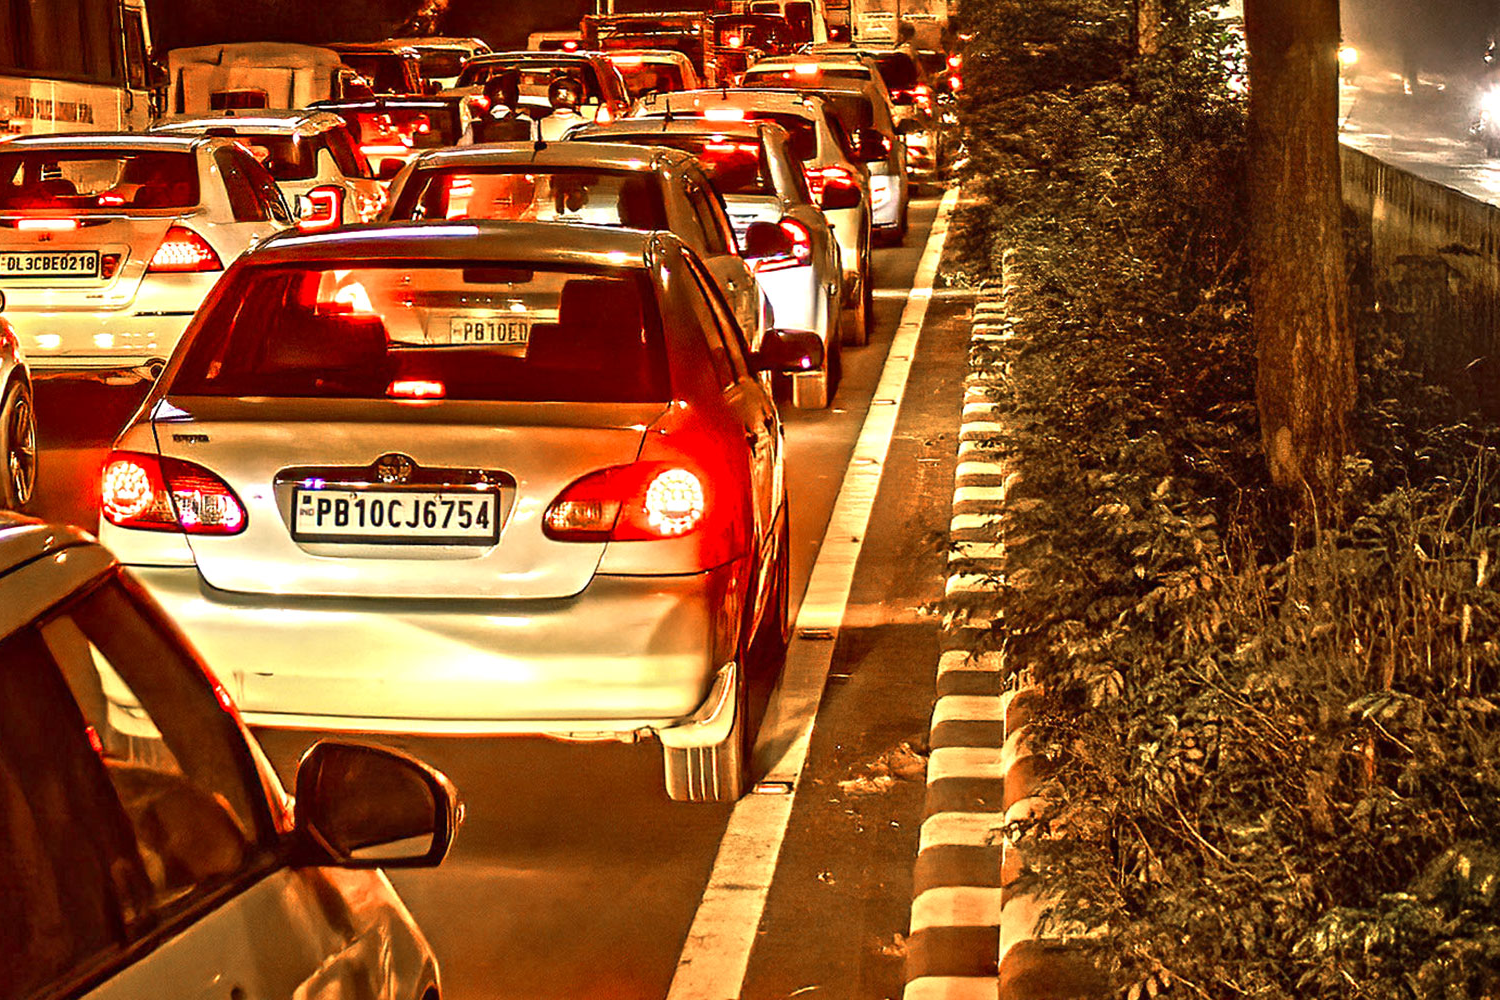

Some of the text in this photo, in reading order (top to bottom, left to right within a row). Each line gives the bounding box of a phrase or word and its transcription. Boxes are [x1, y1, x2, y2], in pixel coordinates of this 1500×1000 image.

[7, 256, 95, 271] DL3CBE0218
[464, 322, 528, 342] PB10ED
[316, 498, 490, 529] PB10CJ6754
